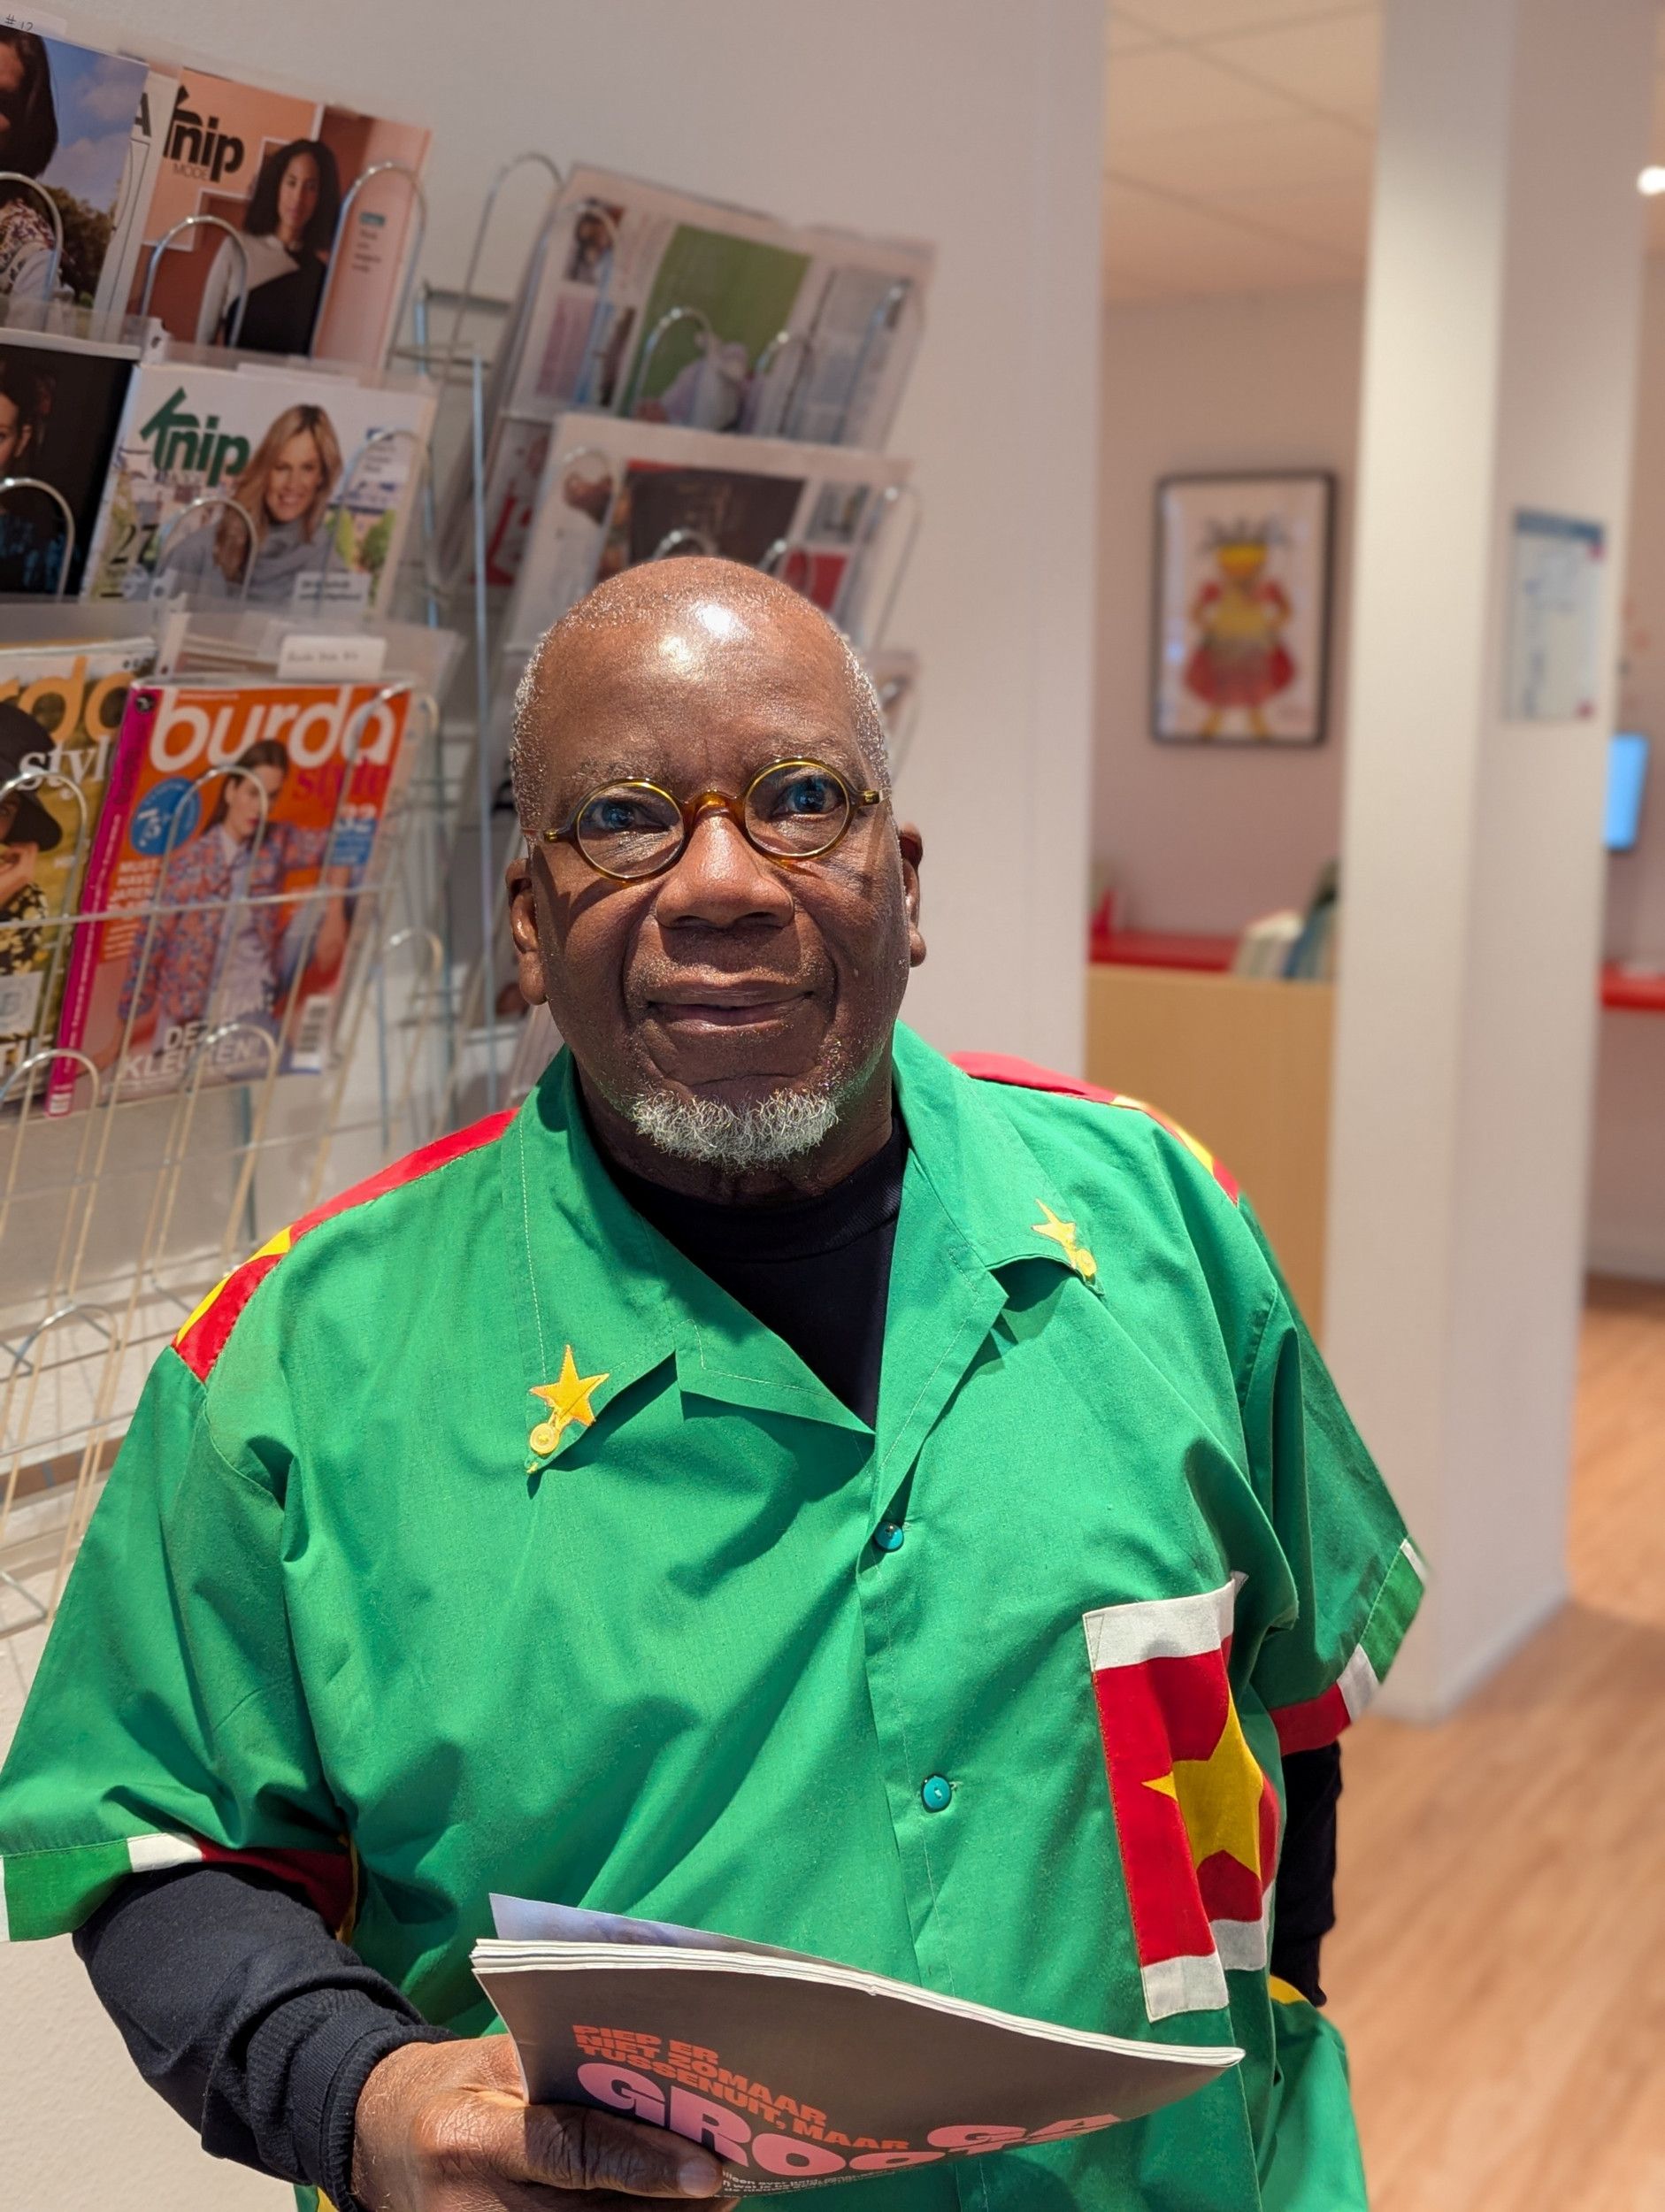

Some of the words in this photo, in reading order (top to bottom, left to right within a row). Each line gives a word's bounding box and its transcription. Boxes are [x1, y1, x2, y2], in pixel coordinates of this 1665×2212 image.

[140, 387, 249, 487] Knip
[16, 735, 111, 800] styl
[150, 685, 395, 773] burda
[572, 2024, 663, 2046] PIEP
[669, 2039, 719, 2066] ER
[575, 2034, 661, 2060] NIET
[668, 2051, 828, 2128] ZOMAAR
[577, 2044, 786, 2131] TUSSENUIT,
[793, 2118, 909, 2150] MAAR
